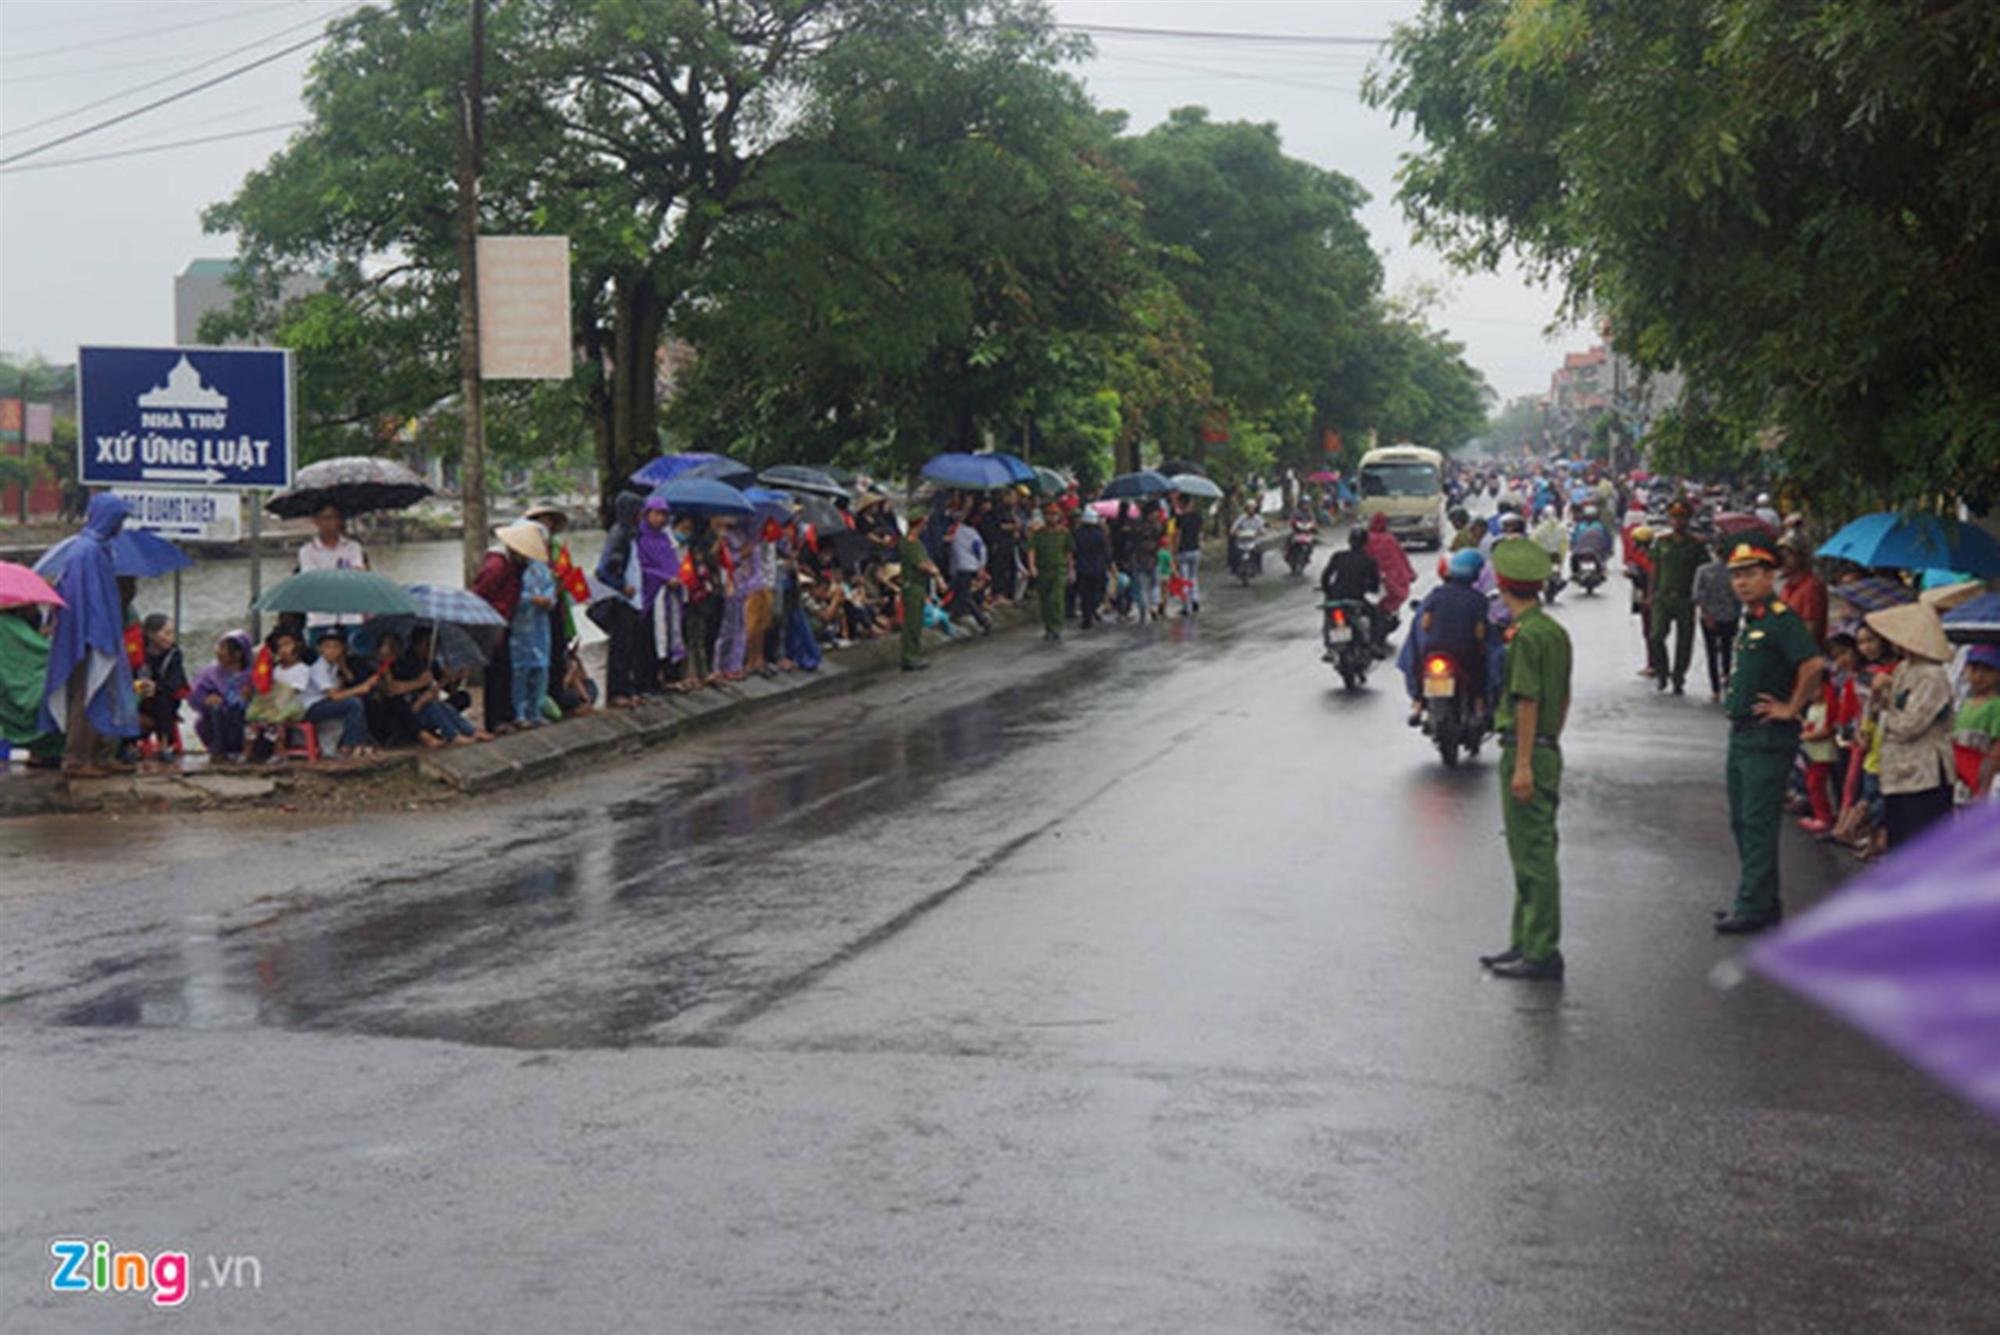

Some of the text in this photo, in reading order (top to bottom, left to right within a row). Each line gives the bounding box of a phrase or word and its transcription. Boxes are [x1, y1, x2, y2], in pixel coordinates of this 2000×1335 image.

[141, 411, 227, 430] NHÀ THỜ
[96, 430, 270, 471] XỨ ỨNG LUẬT
